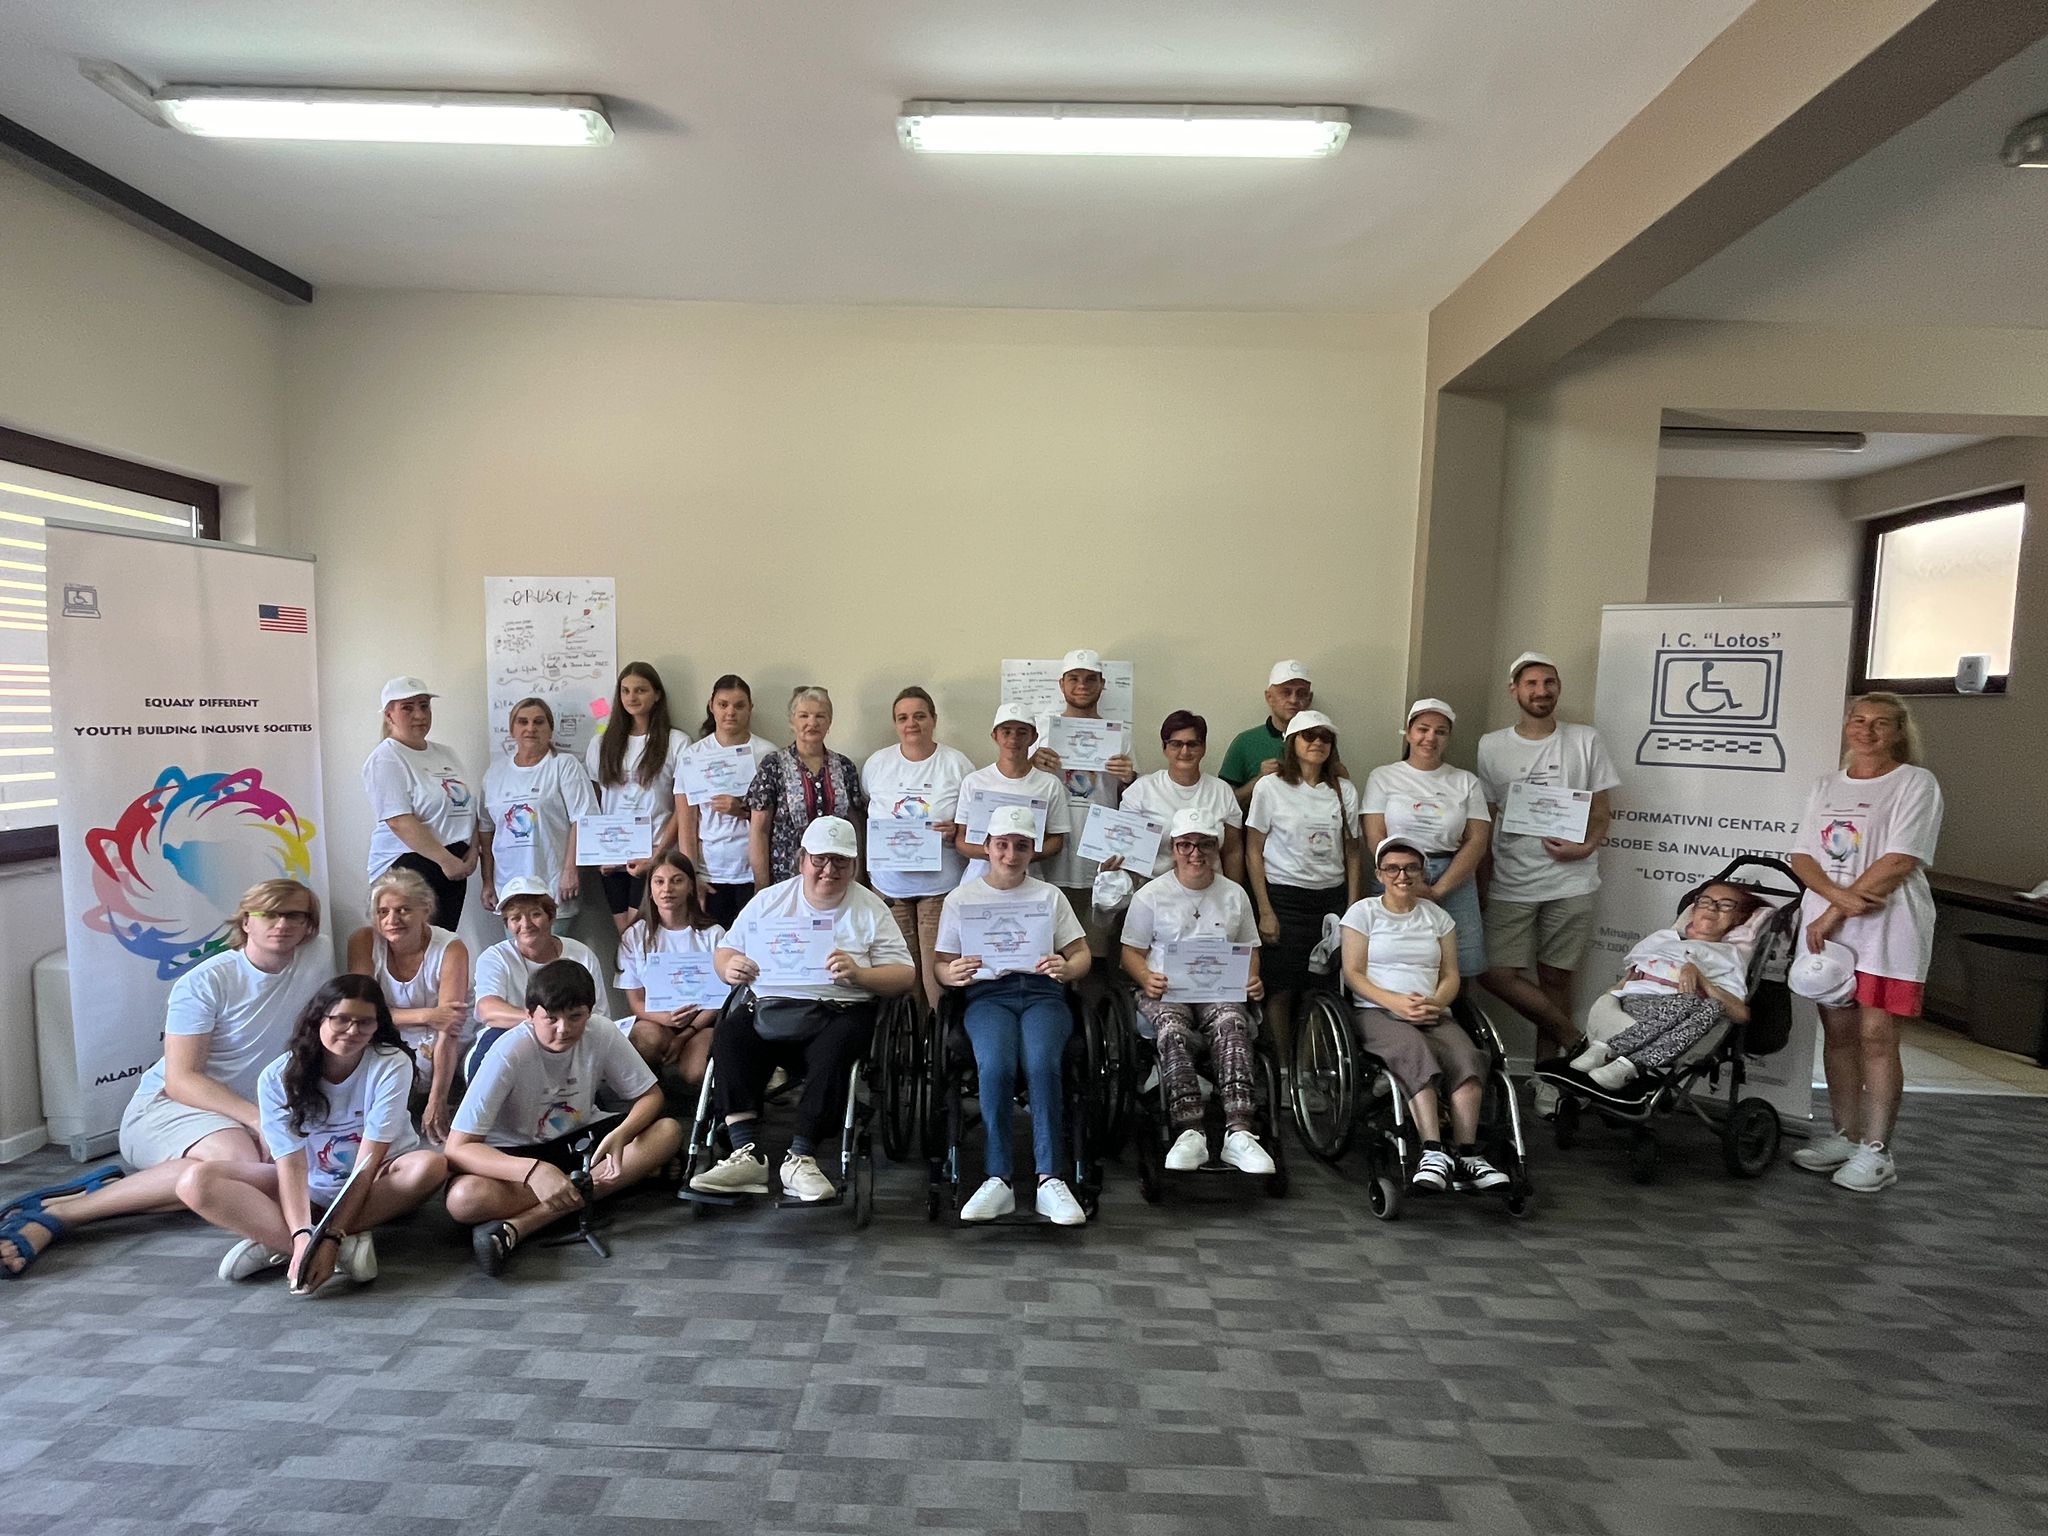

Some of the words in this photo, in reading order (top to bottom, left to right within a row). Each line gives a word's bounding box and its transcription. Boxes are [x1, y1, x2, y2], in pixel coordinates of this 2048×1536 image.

[1661, 632, 1671, 648] I.
[1677, 632, 1697, 648] C.
[145, 698, 195, 708] EQUALY
[199, 698, 260, 708] DIFFERENT
[74, 726, 132, 736] YOUTH
[137, 725, 198, 735] BUILDING
[201, 724, 260, 734] INCLUSIVE
[264, 723, 313, 733] SOCIETIES
[1608, 809, 1713, 829] NFORMATIVNI
[1718, 817, 1786, 833] CENTAR
[1790, 822, 1800, 834] Z
[1600, 837, 1654, 852] OSOBE
[1658, 841, 1679, 854] SA
[95, 1064, 143, 1086] MLADI
